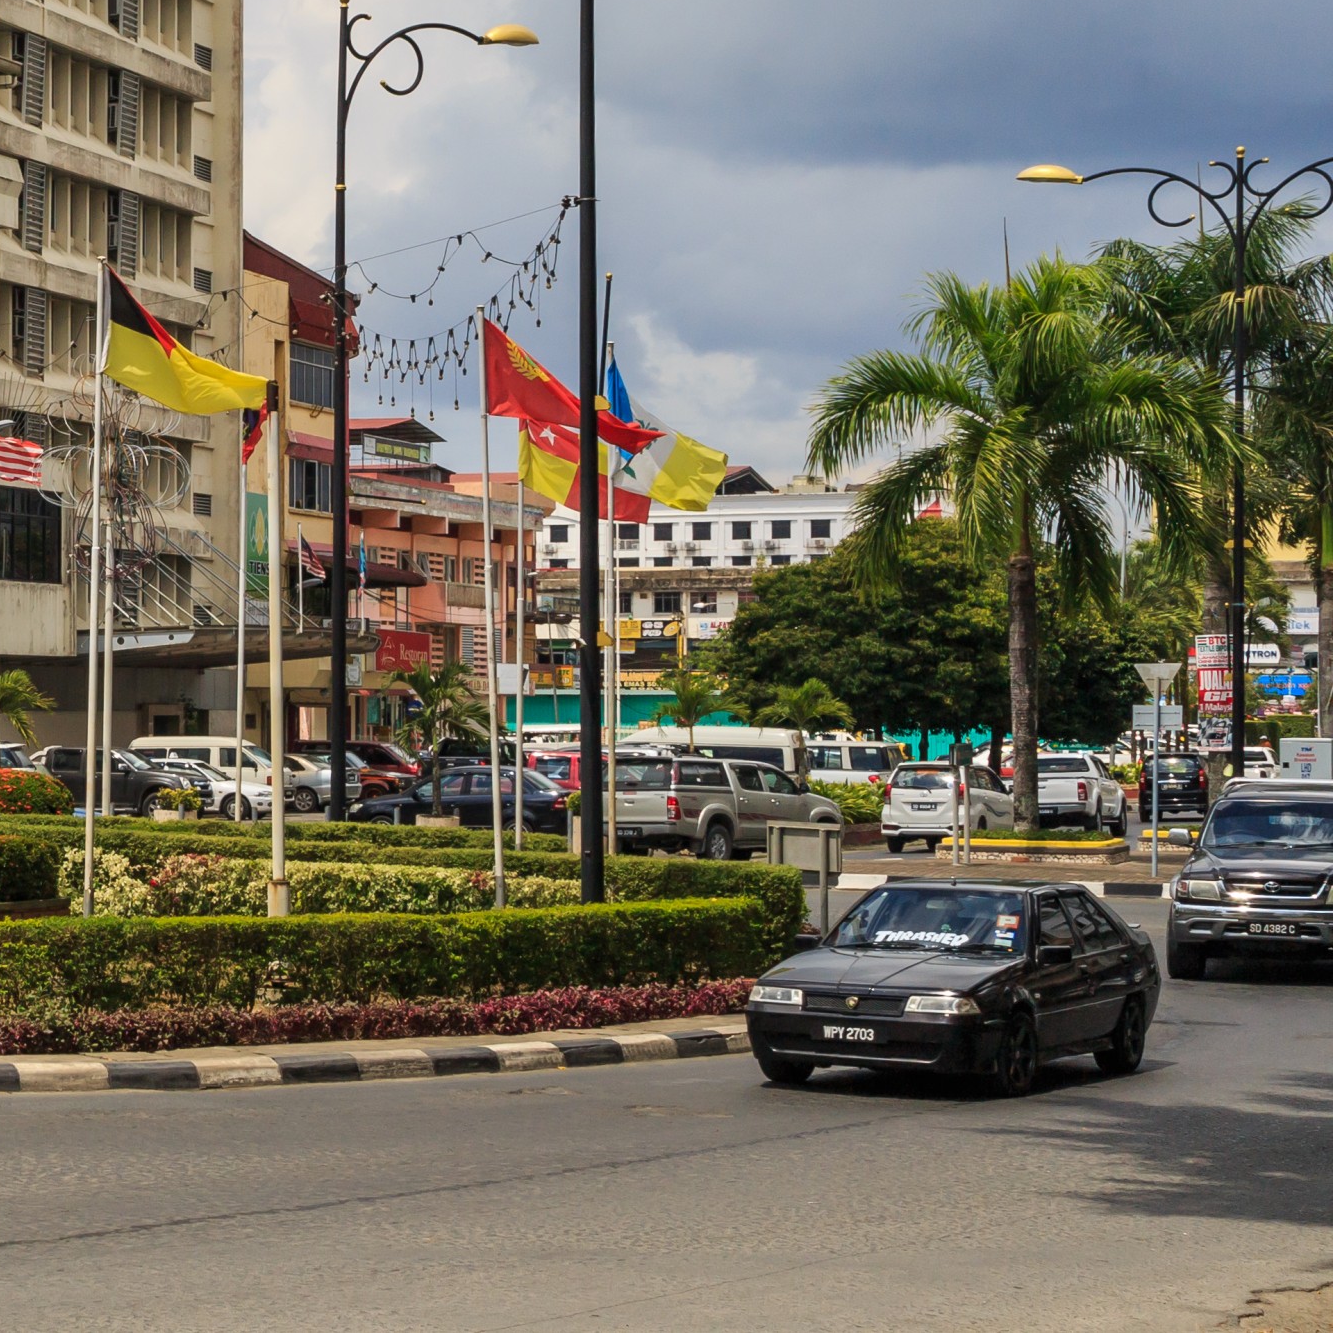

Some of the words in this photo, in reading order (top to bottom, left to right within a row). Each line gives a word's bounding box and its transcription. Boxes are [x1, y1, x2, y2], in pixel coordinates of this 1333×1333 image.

[1208, 636, 1227, 645] BTC
[399, 643, 428, 662] Restoran
[1249, 923, 1262, 933] SD
[1263, 924, 1288, 934] 4382
[1288, 925, 1296, 934] C
[823, 1025, 845, 1039] WPY
[846, 1027, 875, 1041] 2703
